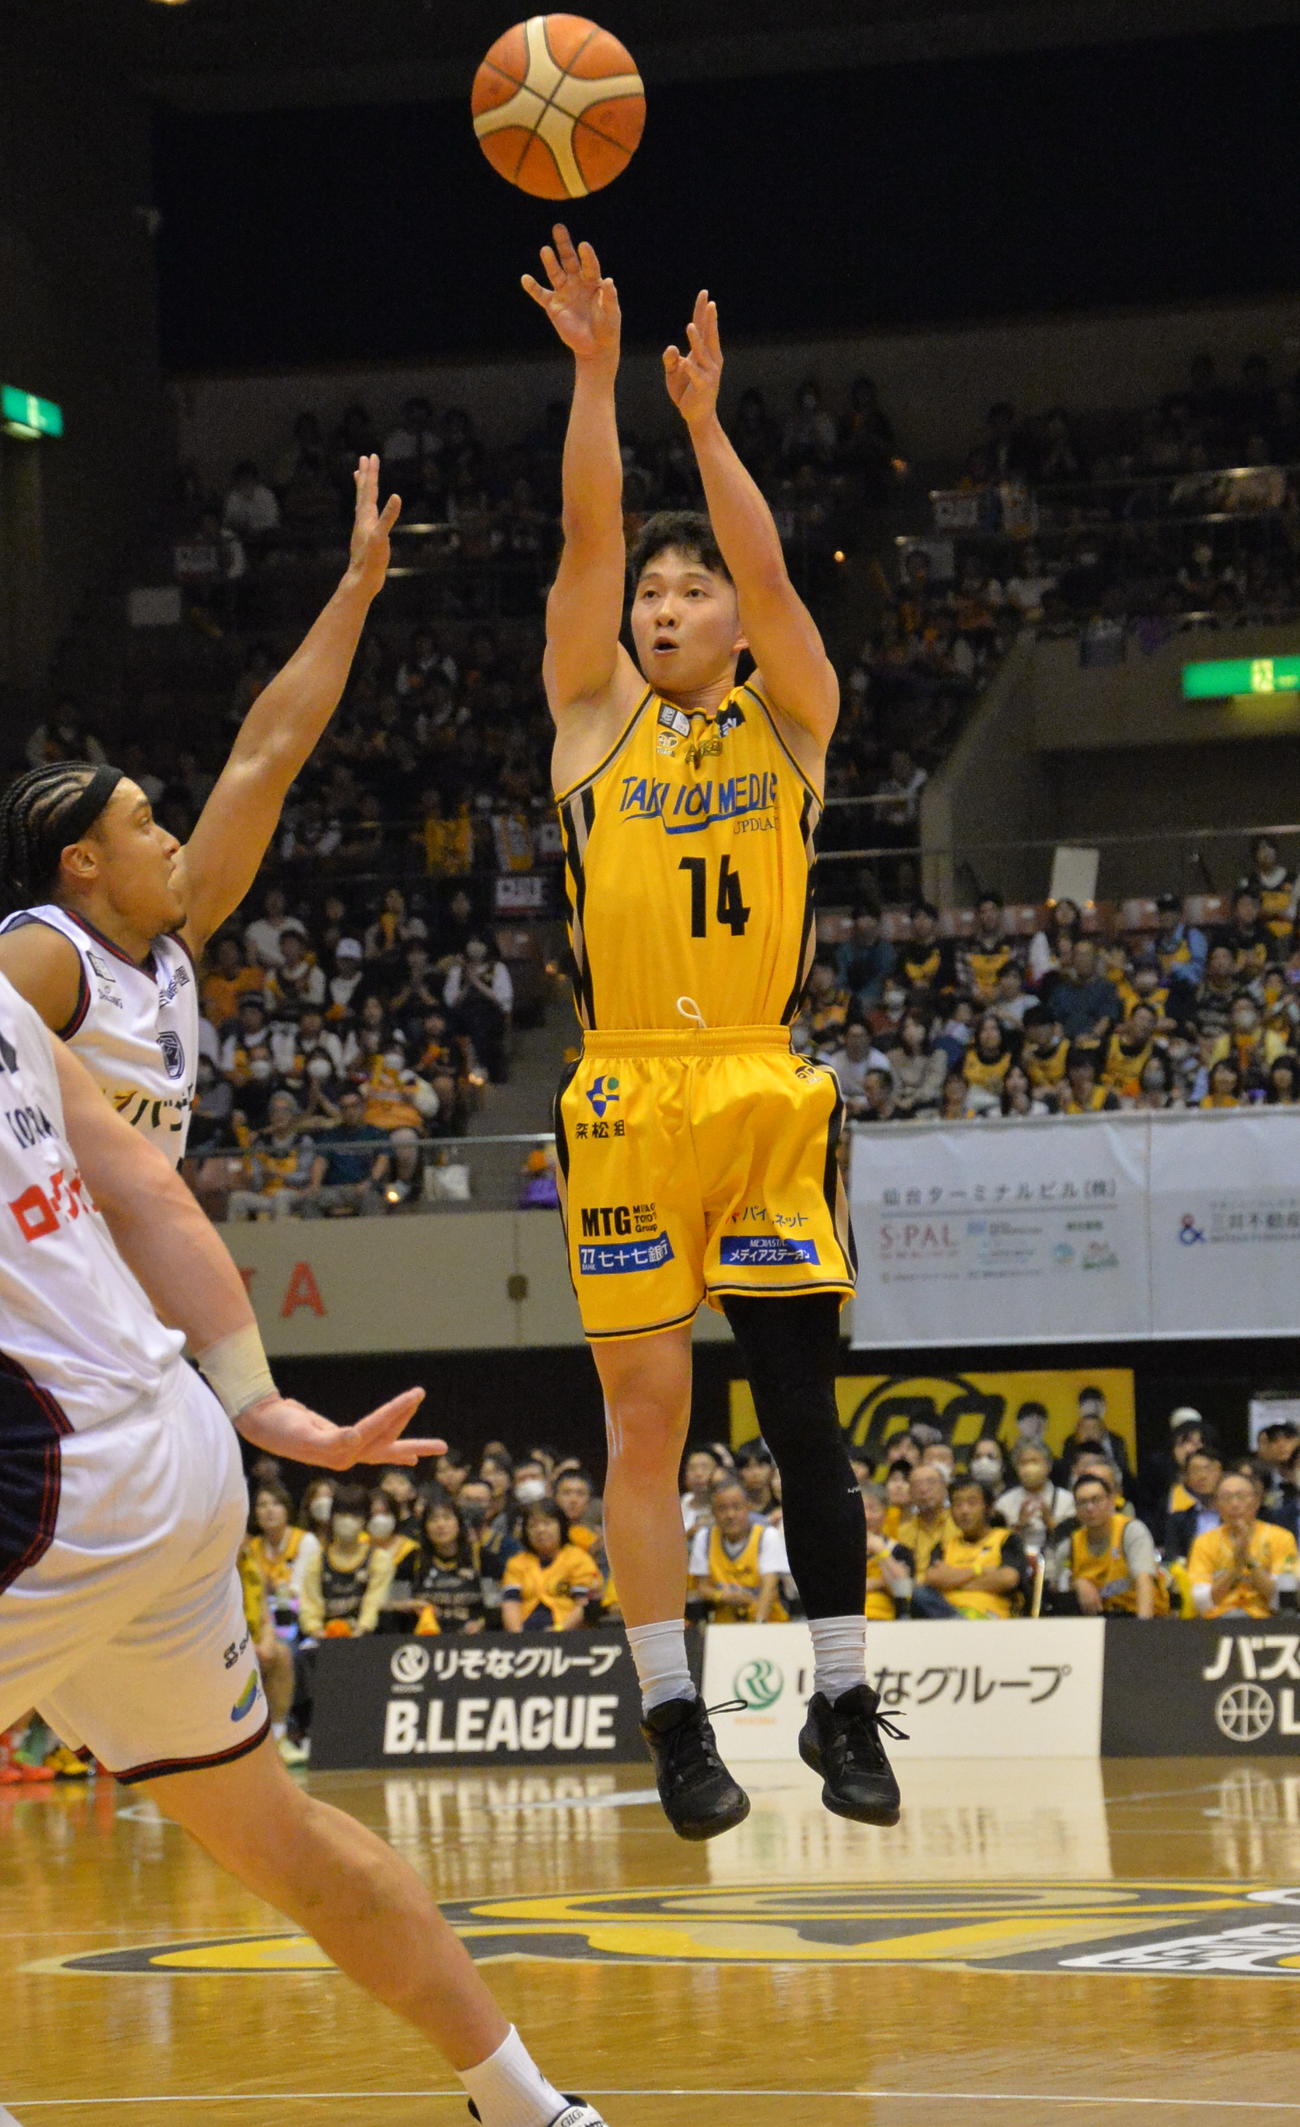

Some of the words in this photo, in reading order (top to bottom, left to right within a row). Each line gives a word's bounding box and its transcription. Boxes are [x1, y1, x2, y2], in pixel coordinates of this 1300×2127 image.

[679, 854, 751, 938] 14
[581, 1206, 632, 1237] MTG
[581, 1249, 596, 1264] 77
[433, 1645, 622, 1681] りそなグループ
[1203, 1635, 1300, 1680] バス
[383, 1694, 619, 1754] B.LEAGUE
